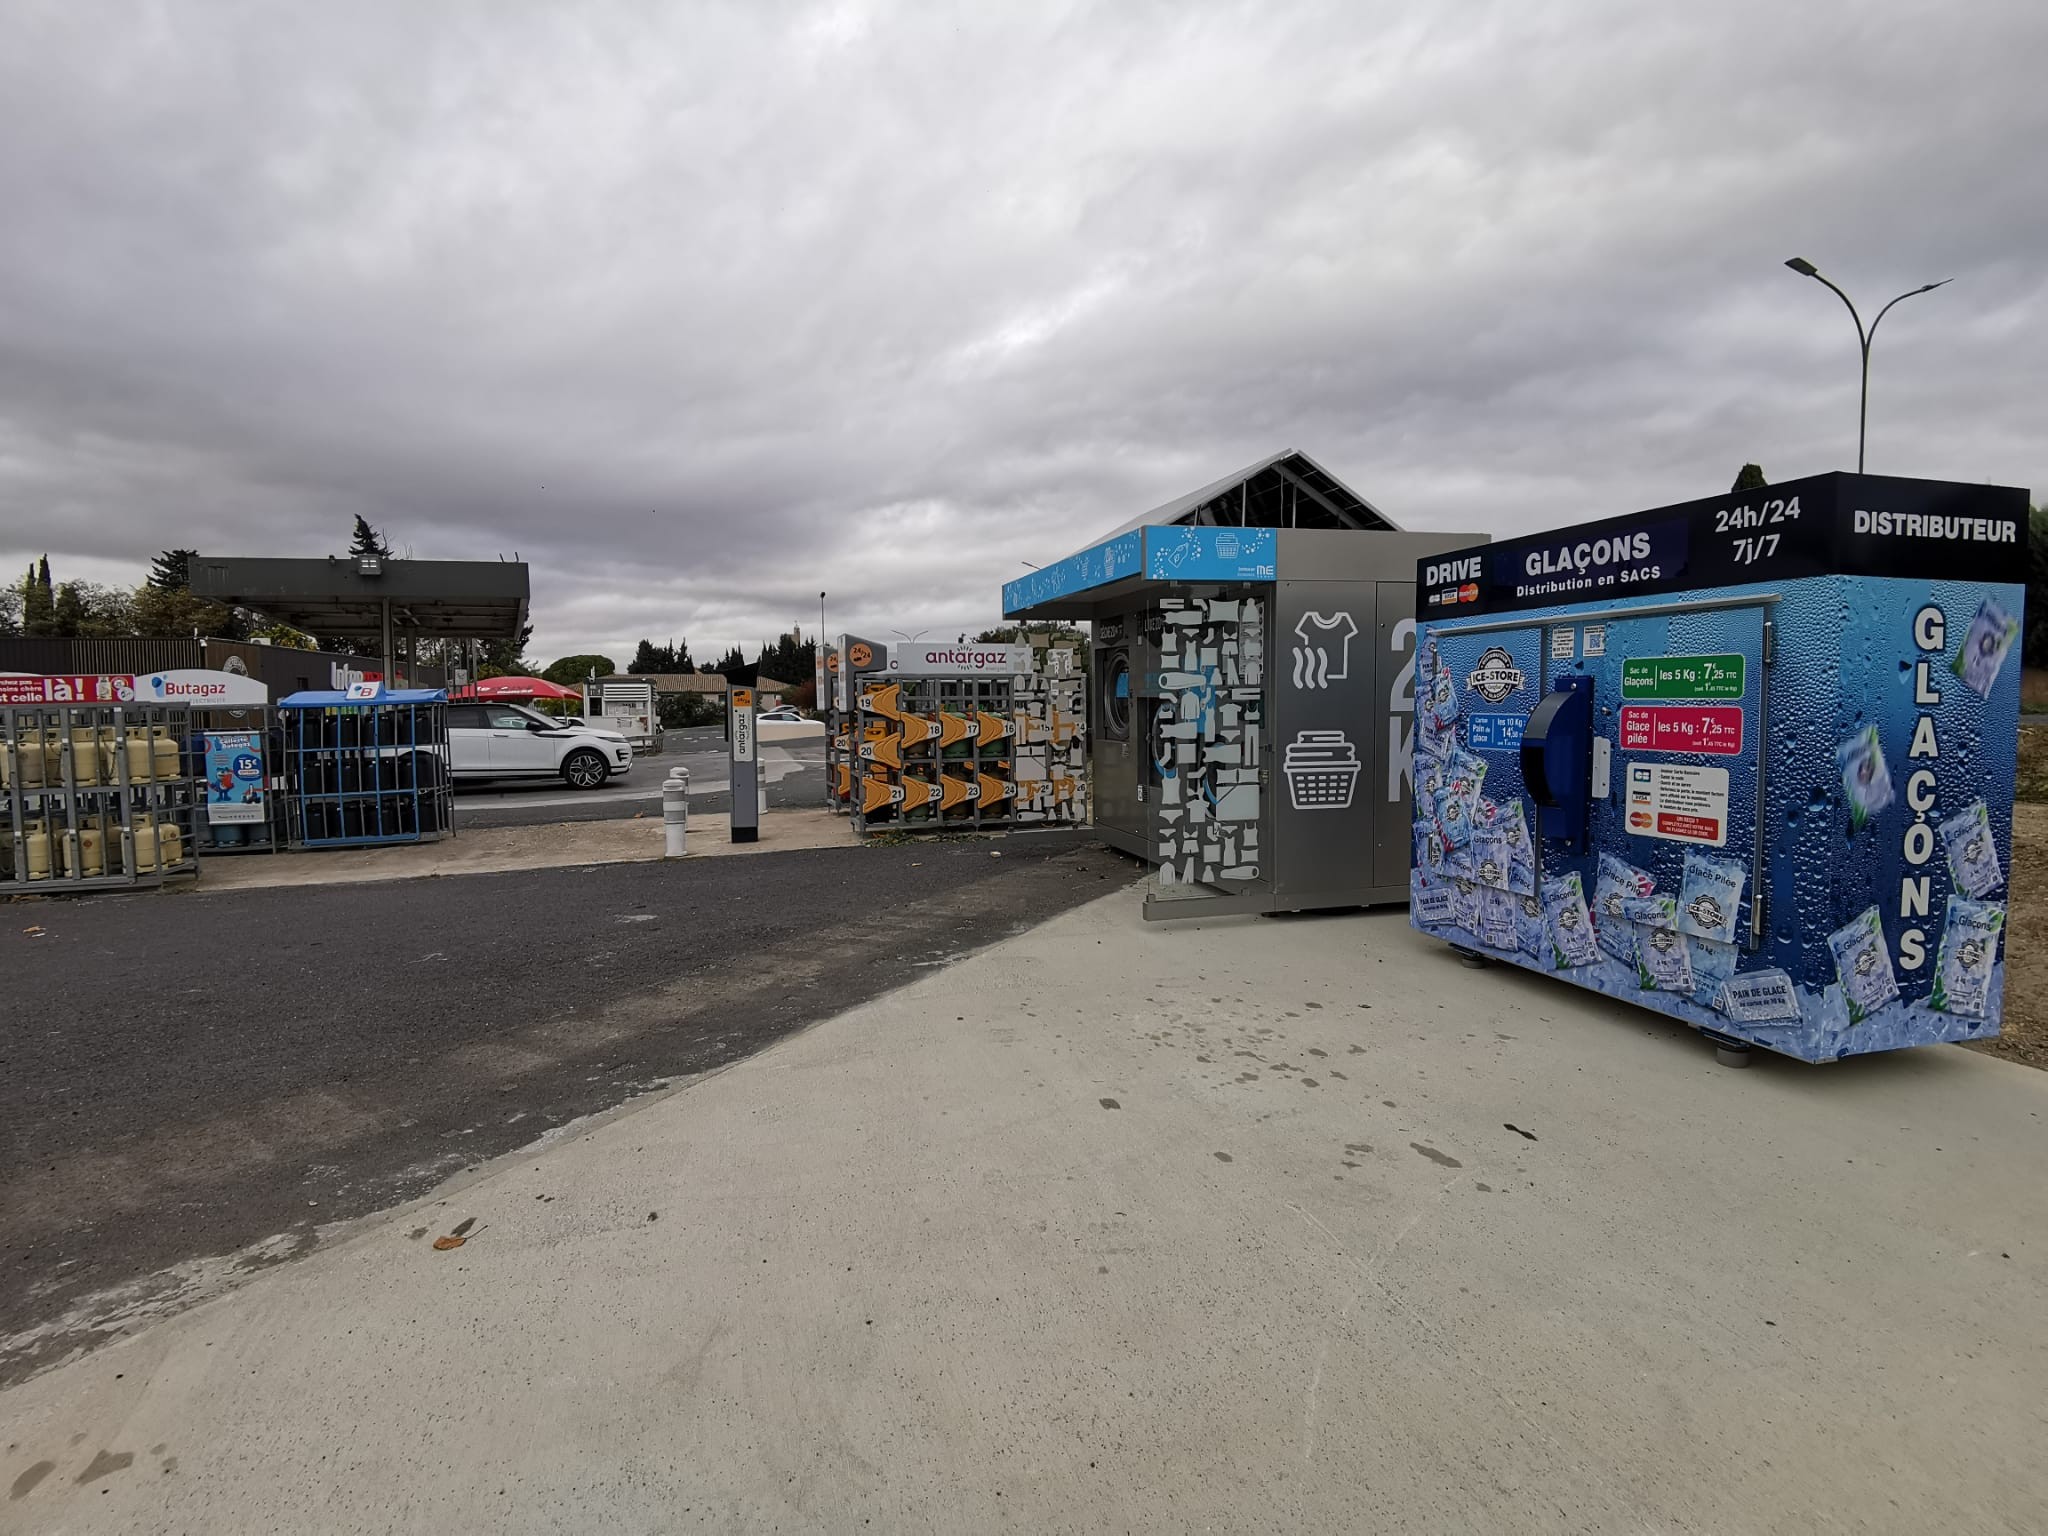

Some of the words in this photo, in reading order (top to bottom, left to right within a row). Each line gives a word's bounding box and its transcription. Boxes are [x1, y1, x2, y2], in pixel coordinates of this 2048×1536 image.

[1715, 496, 1801, 532] 24h/24
[1854, 510, 2016, 543] DISTRIBUTEUR
[1525, 532, 1651, 574] GLAÇONS
[1732, 534, 1780, 565] 7j/7
[1426, 556, 1482, 586] DRIVE
[1517, 576, 1592, 597] Distribution
[1598, 575, 1614, 585] en
[1620, 566, 1661, 583] SACS
[925, 649, 1007, 668] antargaz
[1472, 671, 1518, 682] ICE-STORE
[1660, 669, 1673, 680] les
[1675, 670, 1681, 680] 5
[1683, 669, 1696, 682] Kg
[1624, 677, 1653, 688] Glaçons
[44, 678, 85, 701] là!
[165, 682, 226, 697] Butagaz
[360, 688, 373, 696] B
[11, 692, 43, 702] celle
[860, 699, 871, 707] 19
[1005, 724, 1014, 732] 16
[1472, 724, 1484, 733] Pain
[1507, 718, 1513, 726] 10
[1626, 721, 1650, 731] Glace
[1658, 721, 1671, 732] les
[1673, 722, 1679, 732] 5
[1681, 722, 1694, 735] Kg
[738, 713, 748, 754] antargaz
[931, 726, 940, 734] 18
[967, 725, 978, 733] 17
[837, 739, 846, 747] 20
[1627, 732, 1648, 745] pilée
[861, 747, 872, 755] 20
[892, 790, 901, 798] 21
[930, 789, 941, 797] 22
[968, 787, 978, 796] 23
[1005, 786, 1015, 794] 24
[1953, 820, 1982, 838] Glaçons
[1473, 835, 1502, 844] Glaçons
[1602, 866, 1625, 885] Glace
[1689, 865, 1713, 880] Glace
[1715, 873, 1737, 889] Pilée
[1549, 888, 1577, 901] Glaçons
[1635, 911, 1667, 920] Glaçons
[1690, 904, 1723, 921] ICE-STORE
[1958, 915, 1993, 931] Glaçons
[1843, 927, 1874, 950] Glaçons
[1732, 988, 1750, 998] PAIN
[1751, 988, 1761, 998] DE
[1762, 985, 1787, 997] GLACE
